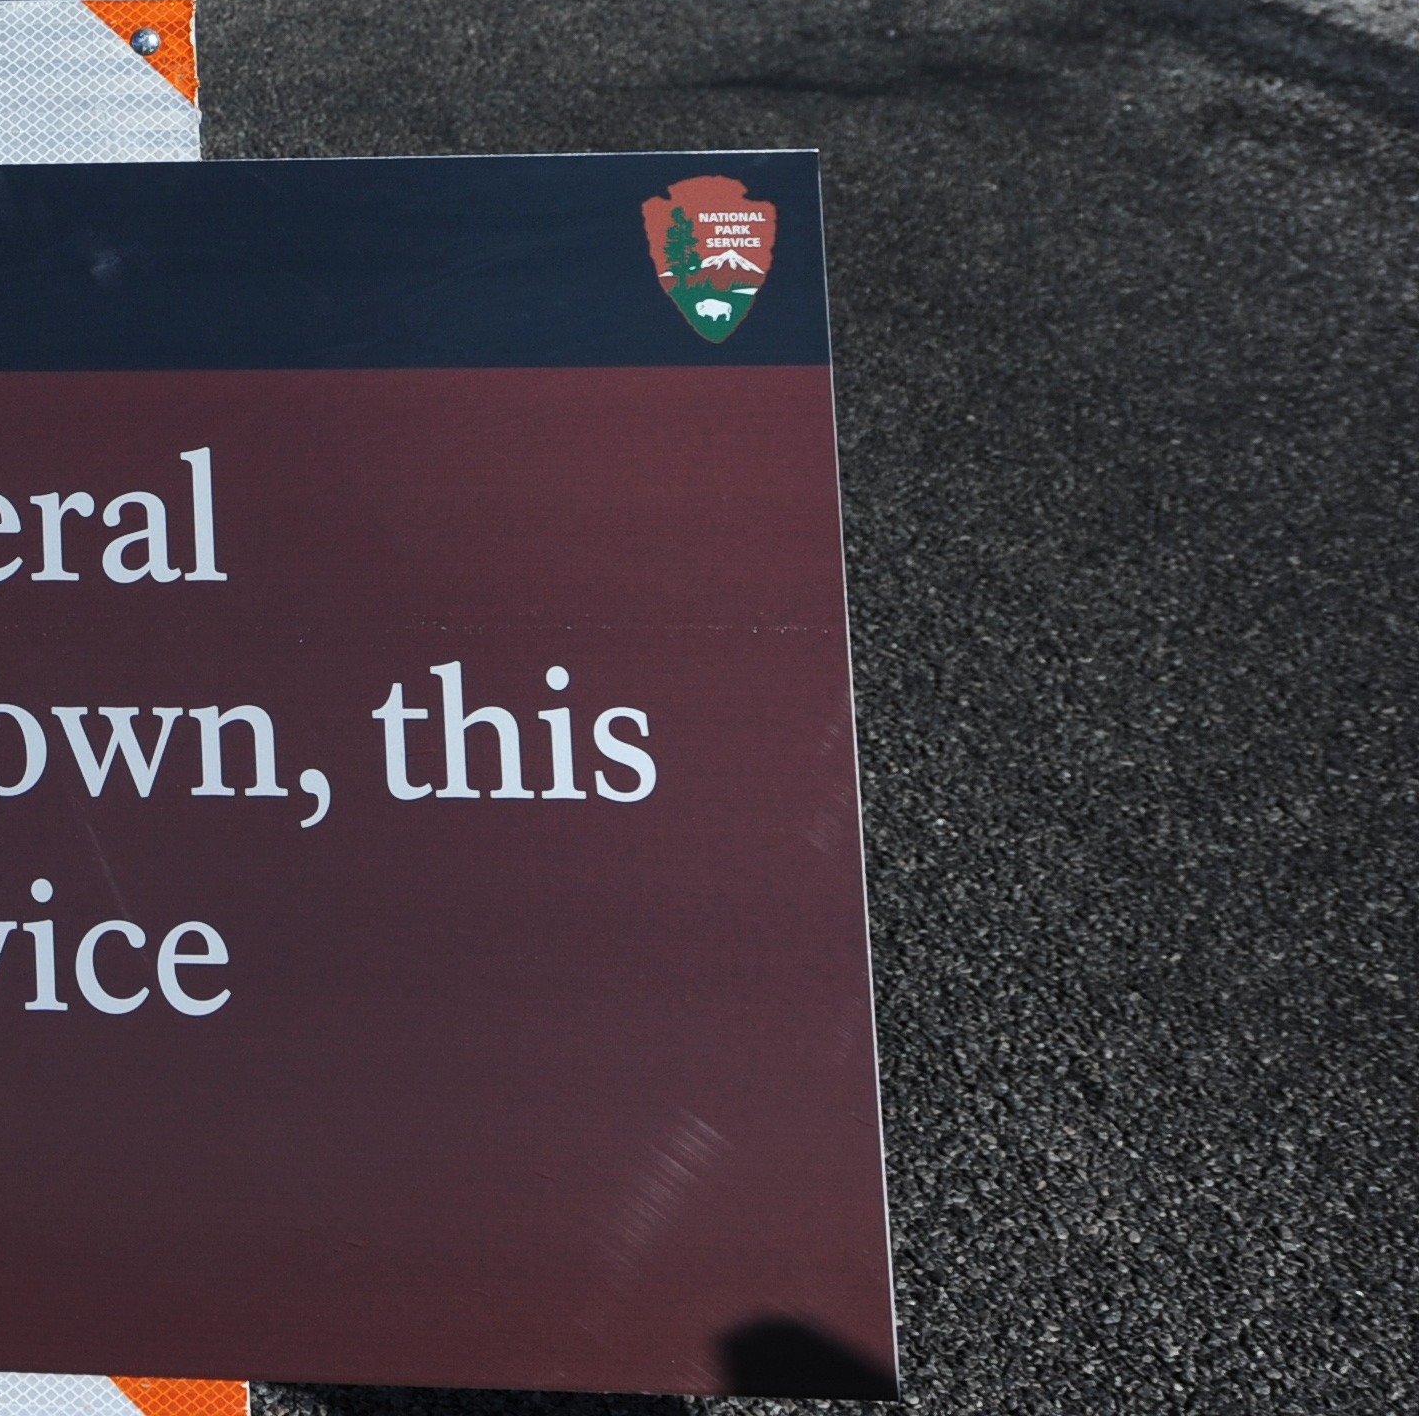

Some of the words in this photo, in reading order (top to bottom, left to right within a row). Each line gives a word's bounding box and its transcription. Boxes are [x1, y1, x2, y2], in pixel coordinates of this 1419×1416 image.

[698, 212, 766, 223] NATIONAL
[714, 225, 751, 235] PARK
[706, 237, 762, 248] SERVICE
[371, 660, 657, 806] this
